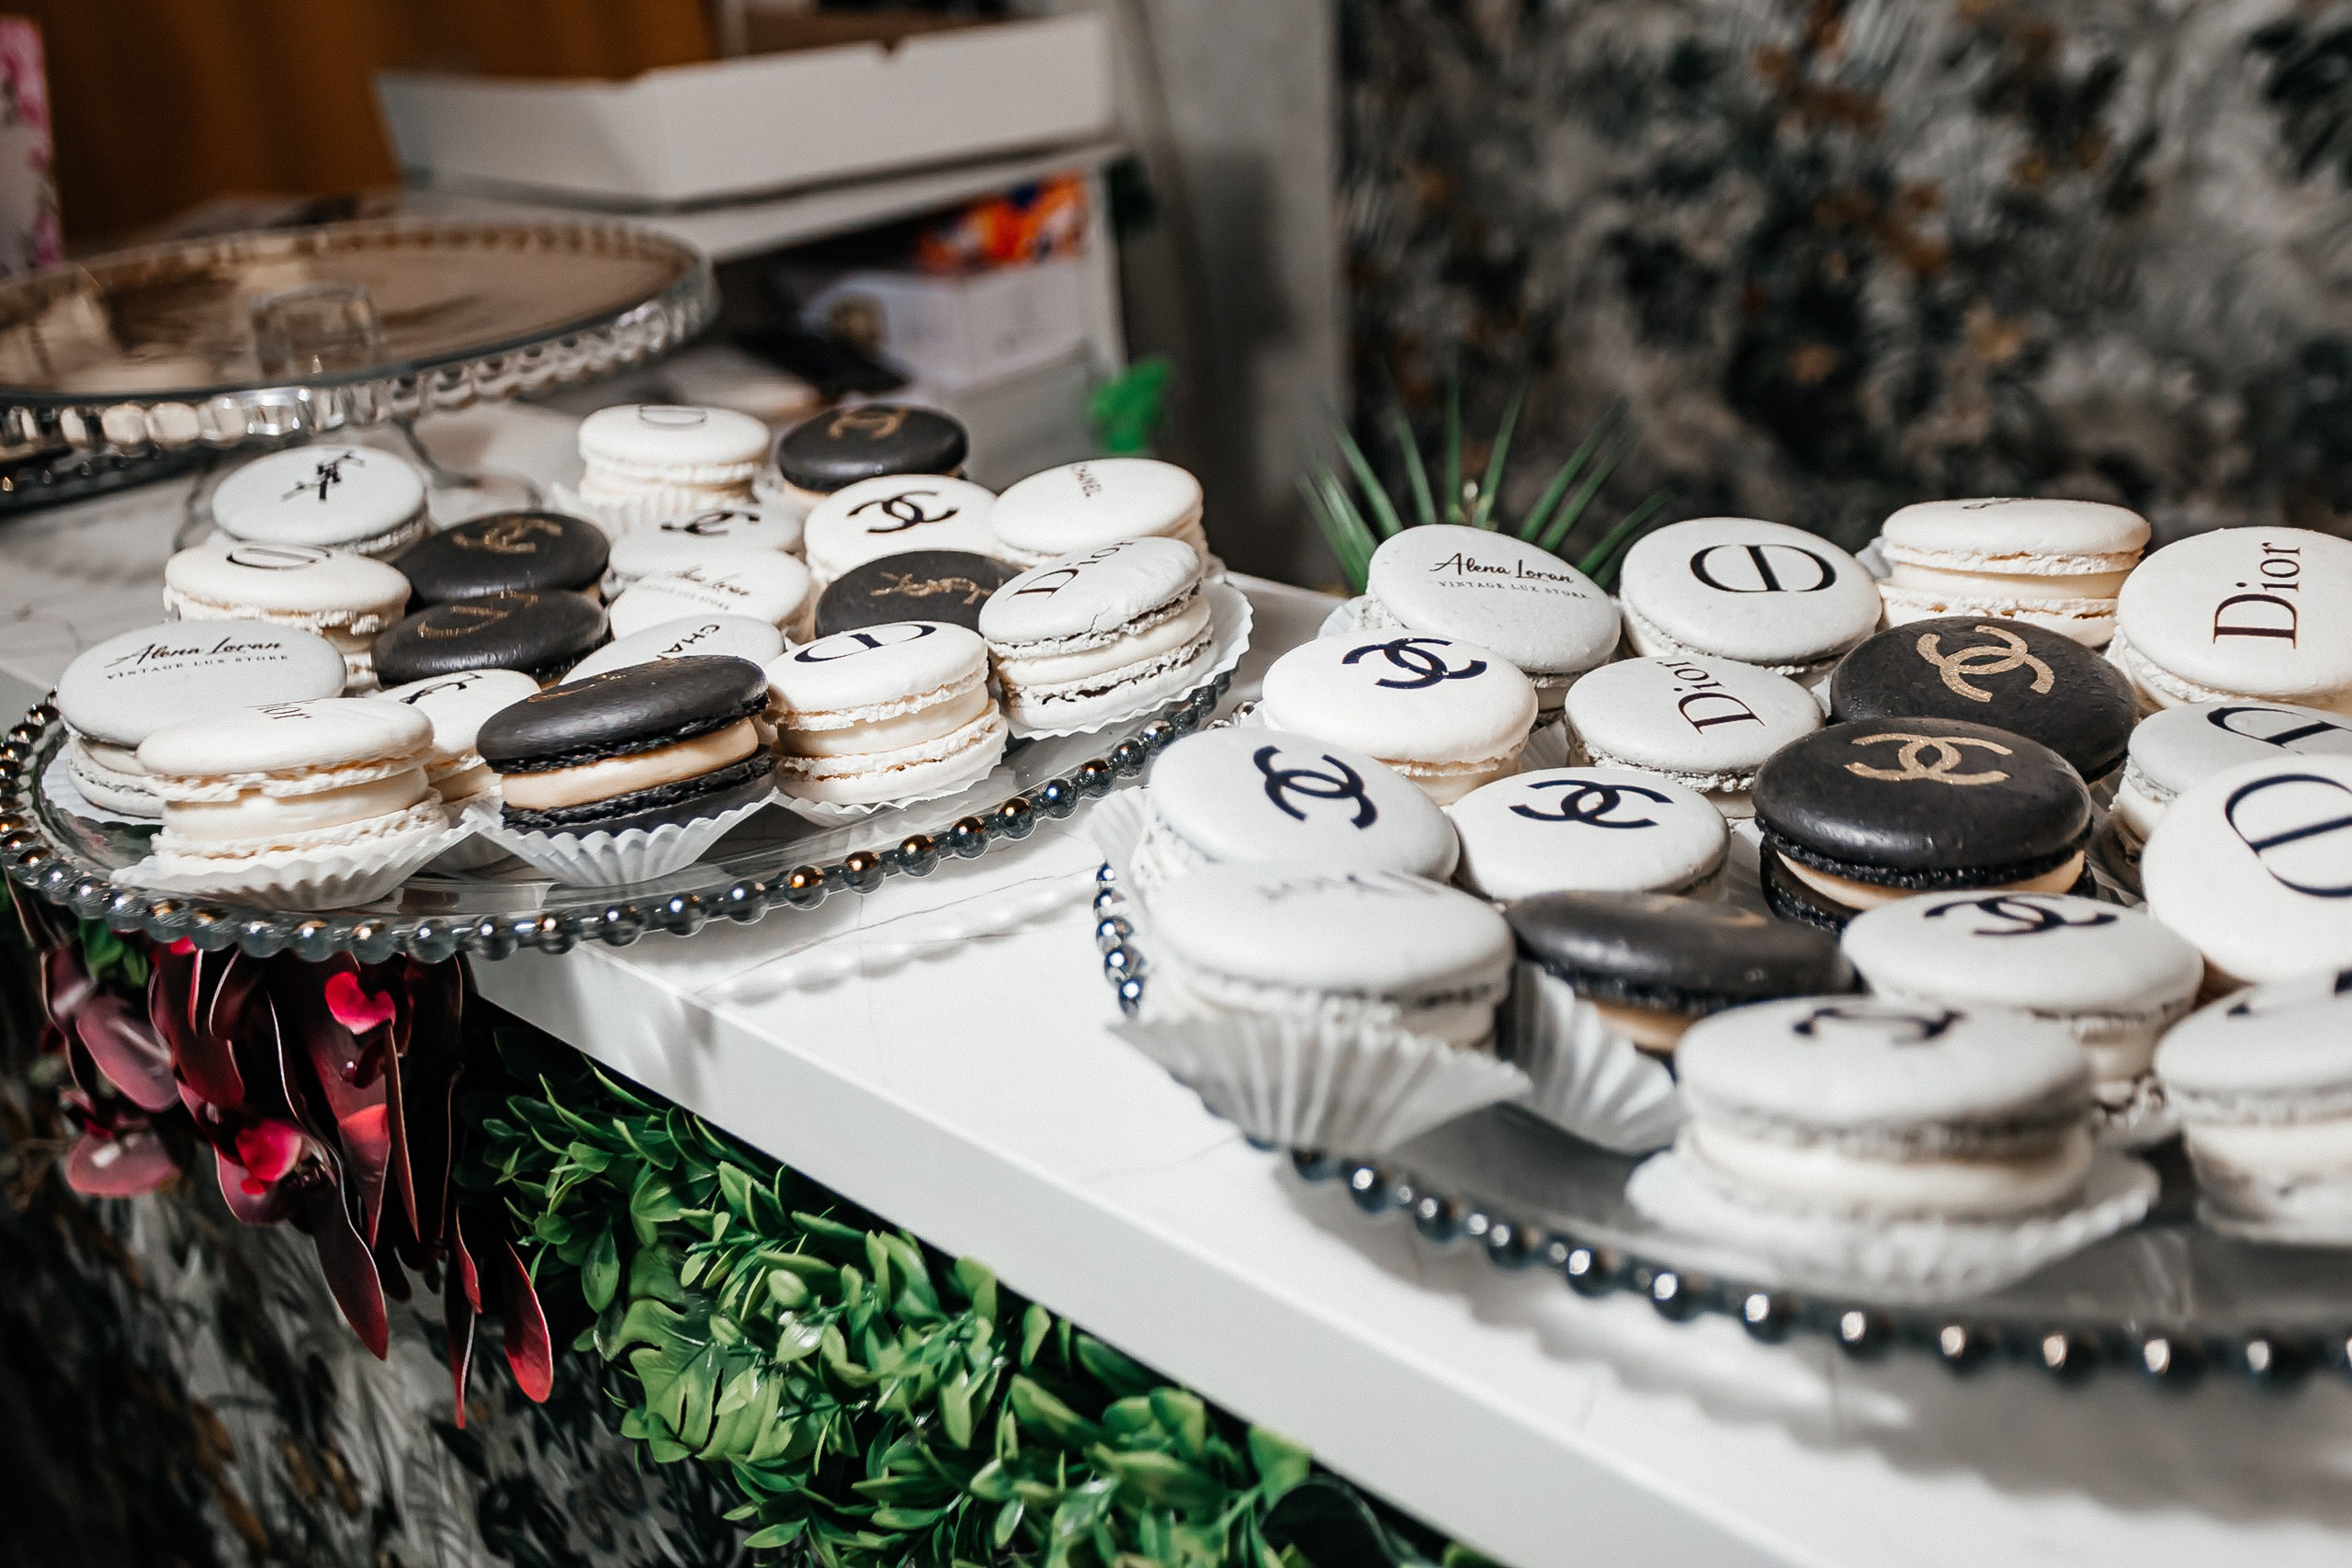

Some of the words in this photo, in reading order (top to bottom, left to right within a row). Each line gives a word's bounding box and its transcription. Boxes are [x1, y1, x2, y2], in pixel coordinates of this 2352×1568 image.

[1005, 540, 1136, 601] Dior
[1430, 552, 1511, 576] Alena
[1515, 558, 1574, 583] Loran
[2212, 542, 2301, 649] Dior
[1657, 660, 1767, 735] Dior
